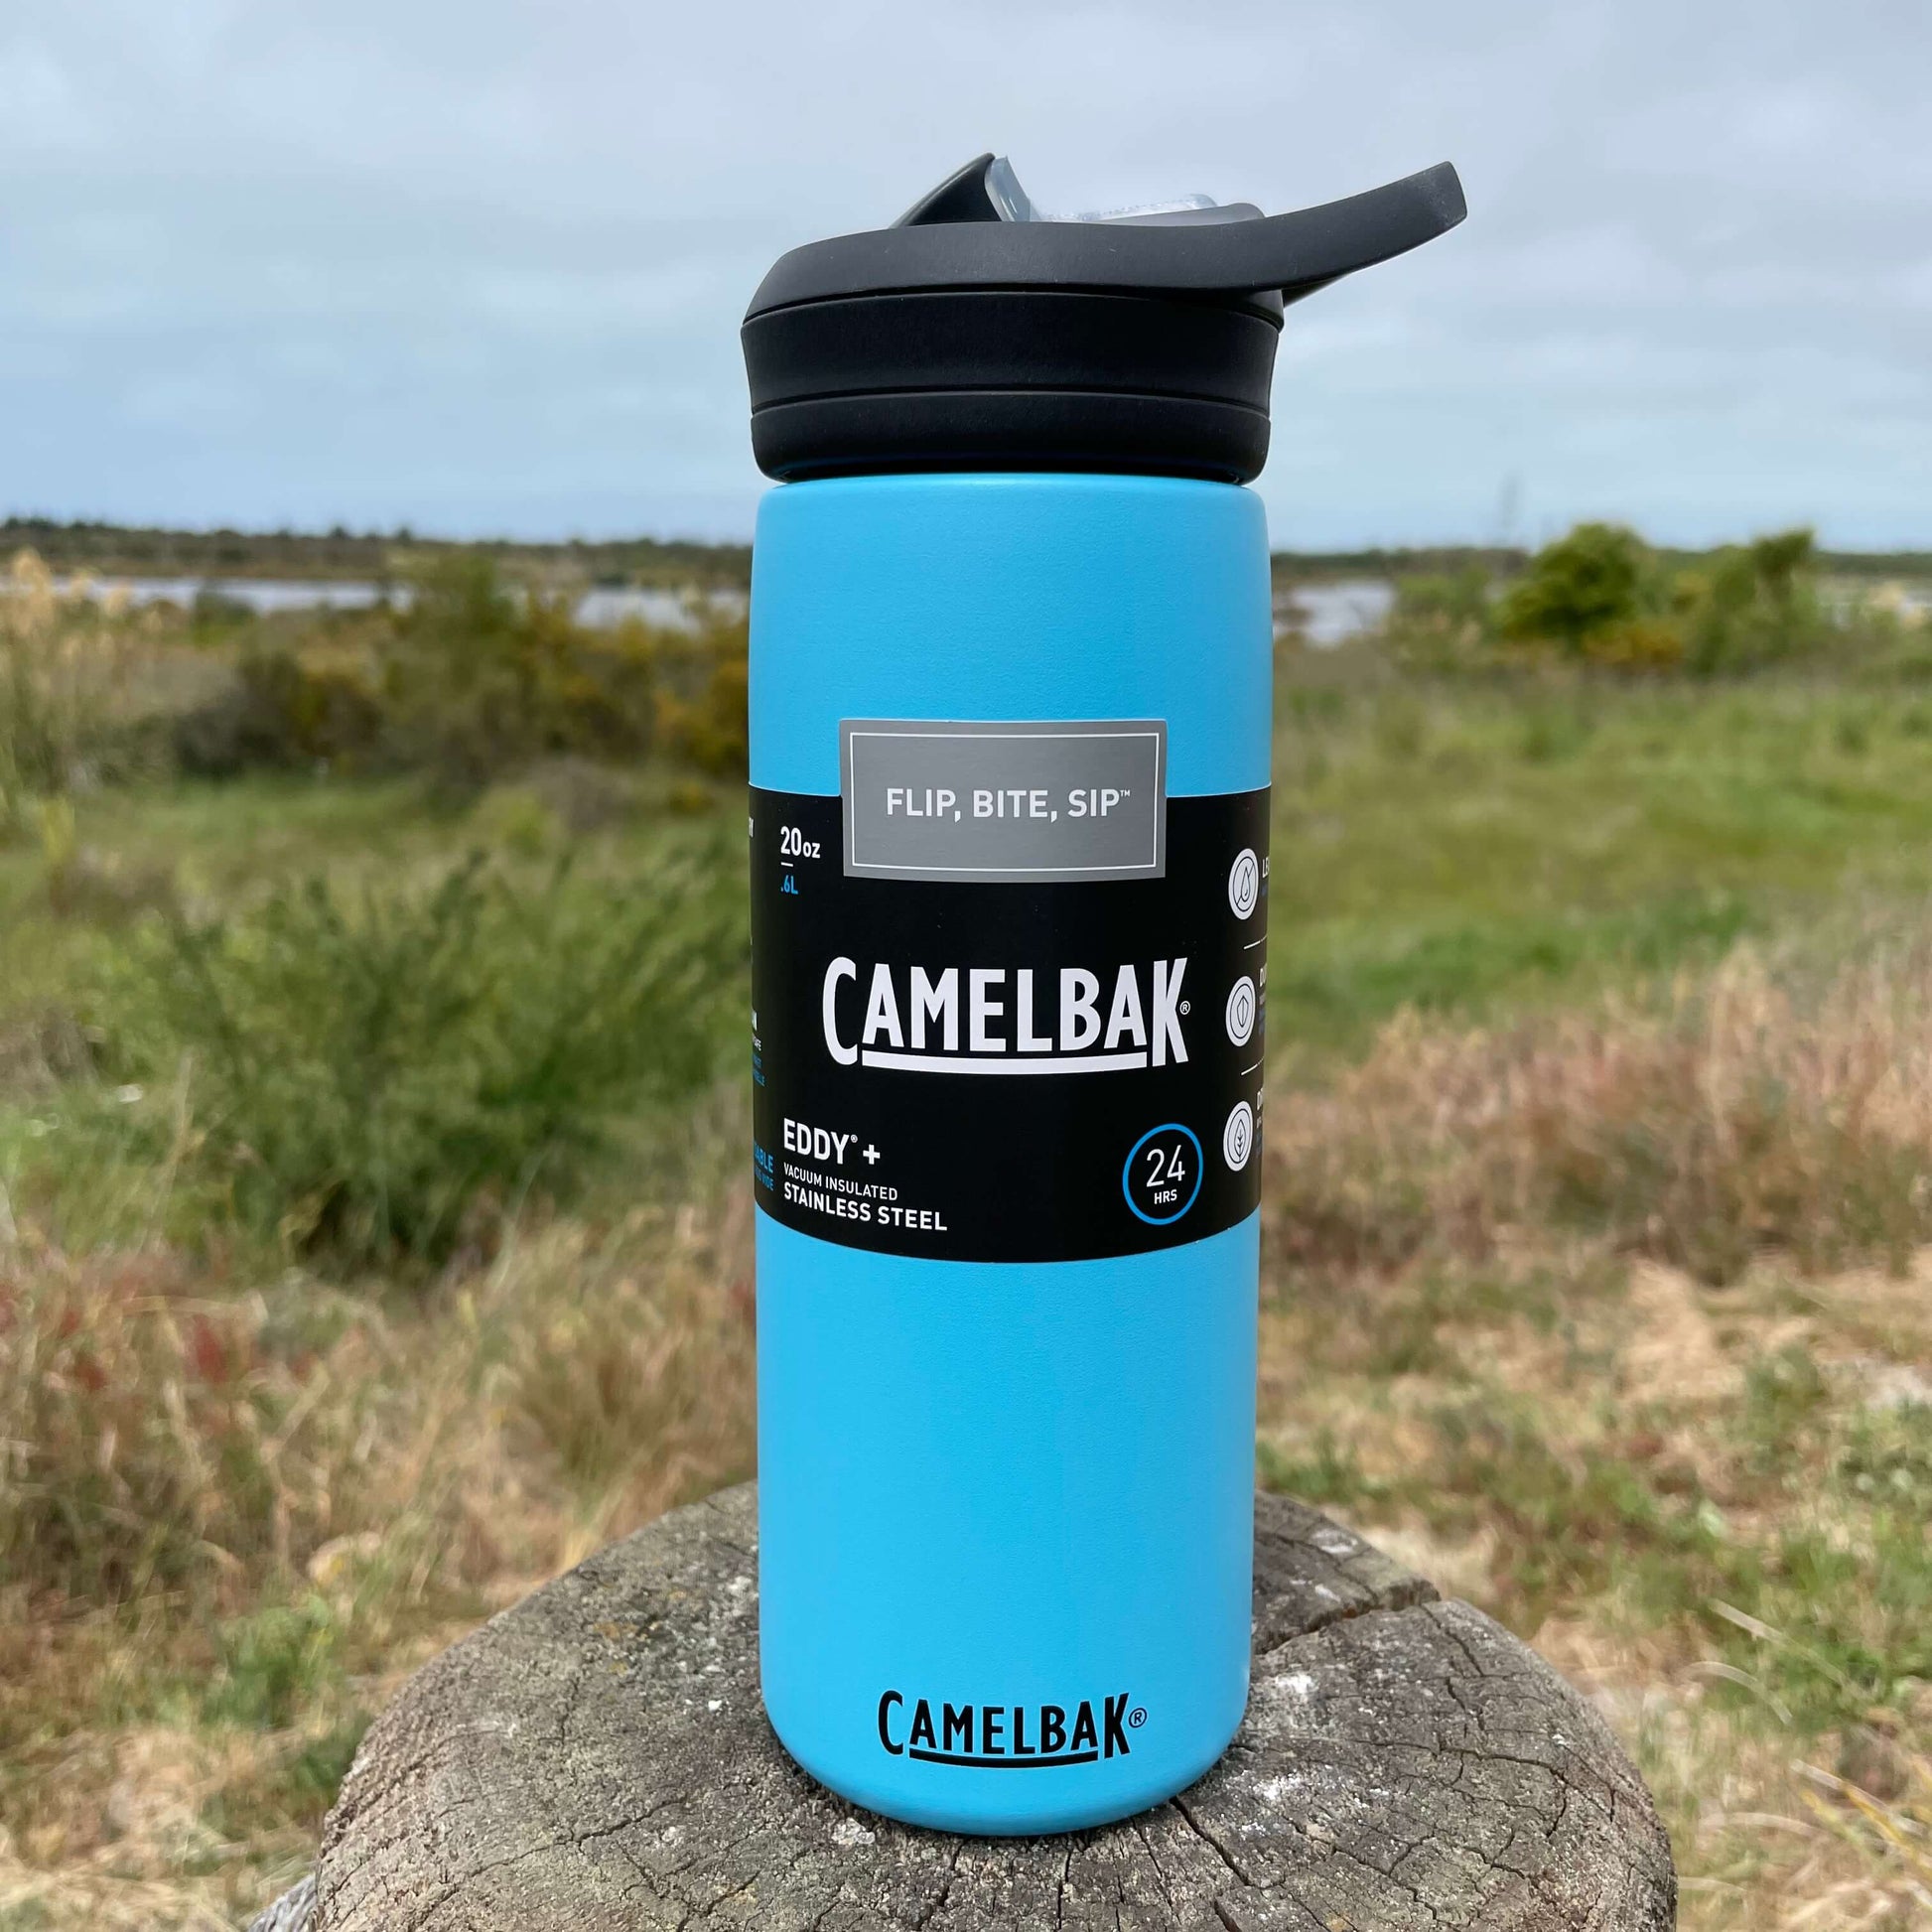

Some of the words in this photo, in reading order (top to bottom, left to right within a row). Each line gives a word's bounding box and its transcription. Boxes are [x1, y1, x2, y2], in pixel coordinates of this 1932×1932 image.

[887, 787, 961, 823] FLIP,
[973, 789, 1057, 823] BITE,
[780, 875, 799, 895] .6L
[783, 1162, 823, 1187] VACUUM
[825, 1175, 898, 1201] INSULATED
[1146, 1144, 1186, 1187] 24
[784, 1181, 872, 1222] STAINLESS
[878, 1205, 948, 1231] STEEL
[1154, 1188, 1177, 1204] HRS
